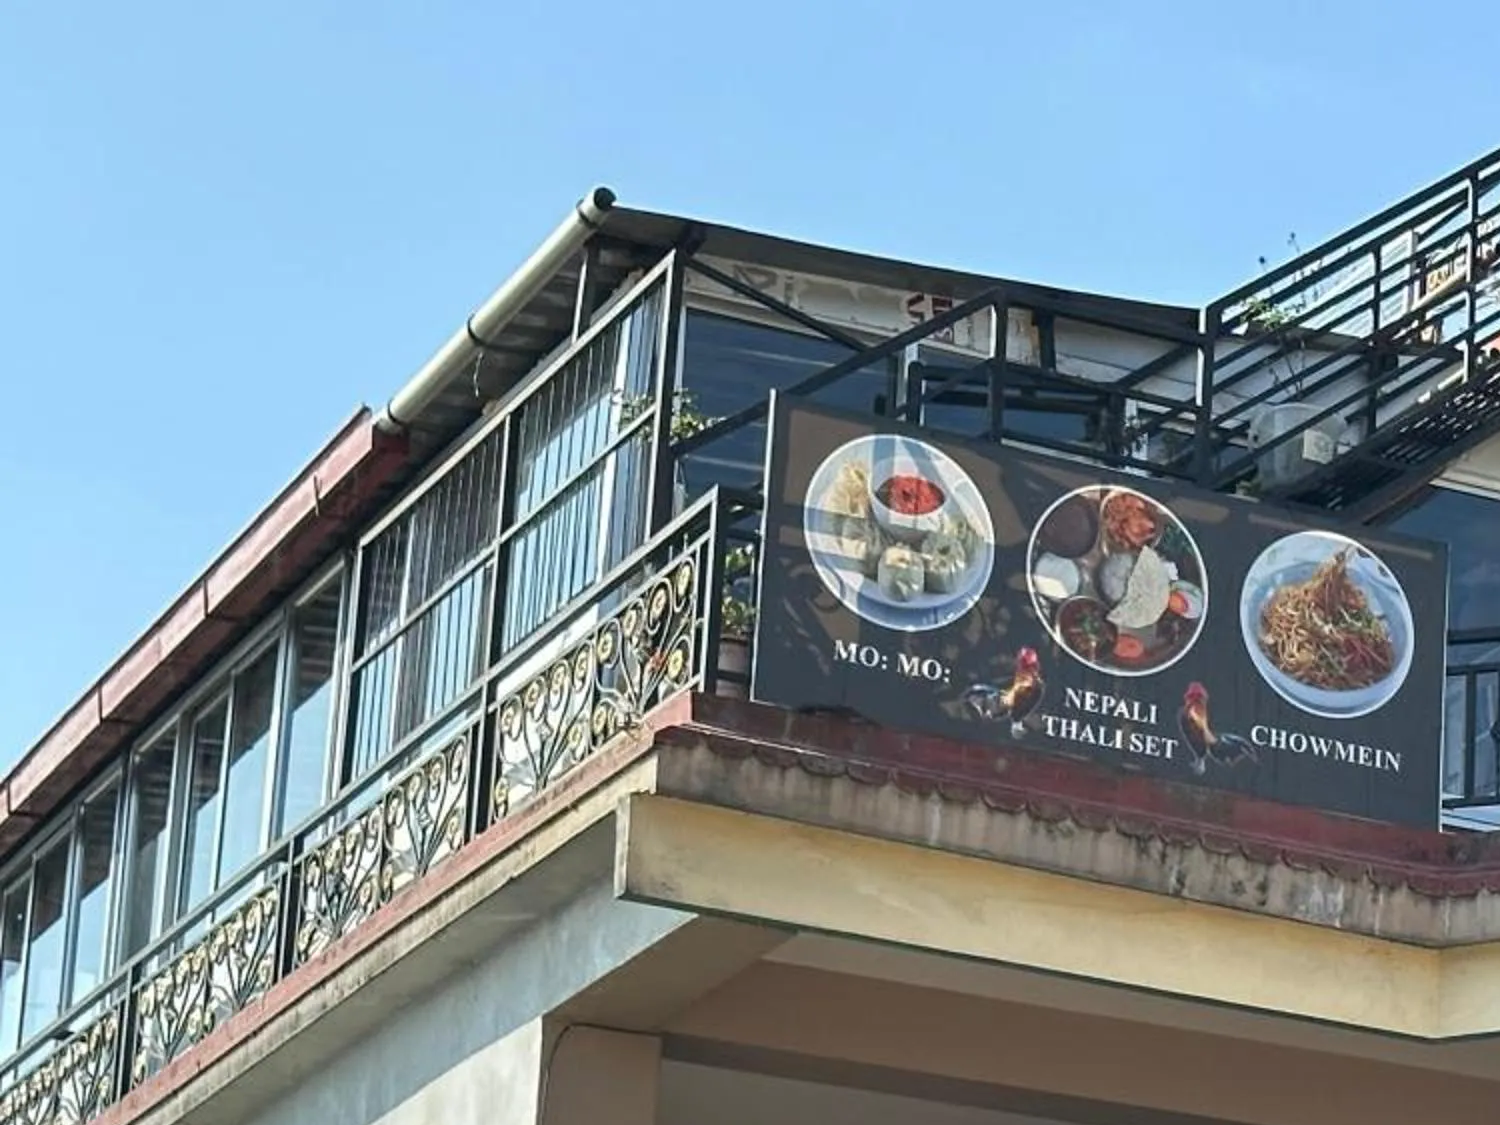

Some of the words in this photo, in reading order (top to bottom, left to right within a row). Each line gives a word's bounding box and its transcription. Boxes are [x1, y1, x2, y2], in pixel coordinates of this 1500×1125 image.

[835, 639, 888, 671] MO:
[897, 656, 951, 683] MO:
[1064, 688, 1157, 724] NEPALI
[1043, 715, 1124, 749] THALI
[1129, 733, 1178, 759] SET
[1250, 725, 1401, 772] CHOWMEIN
